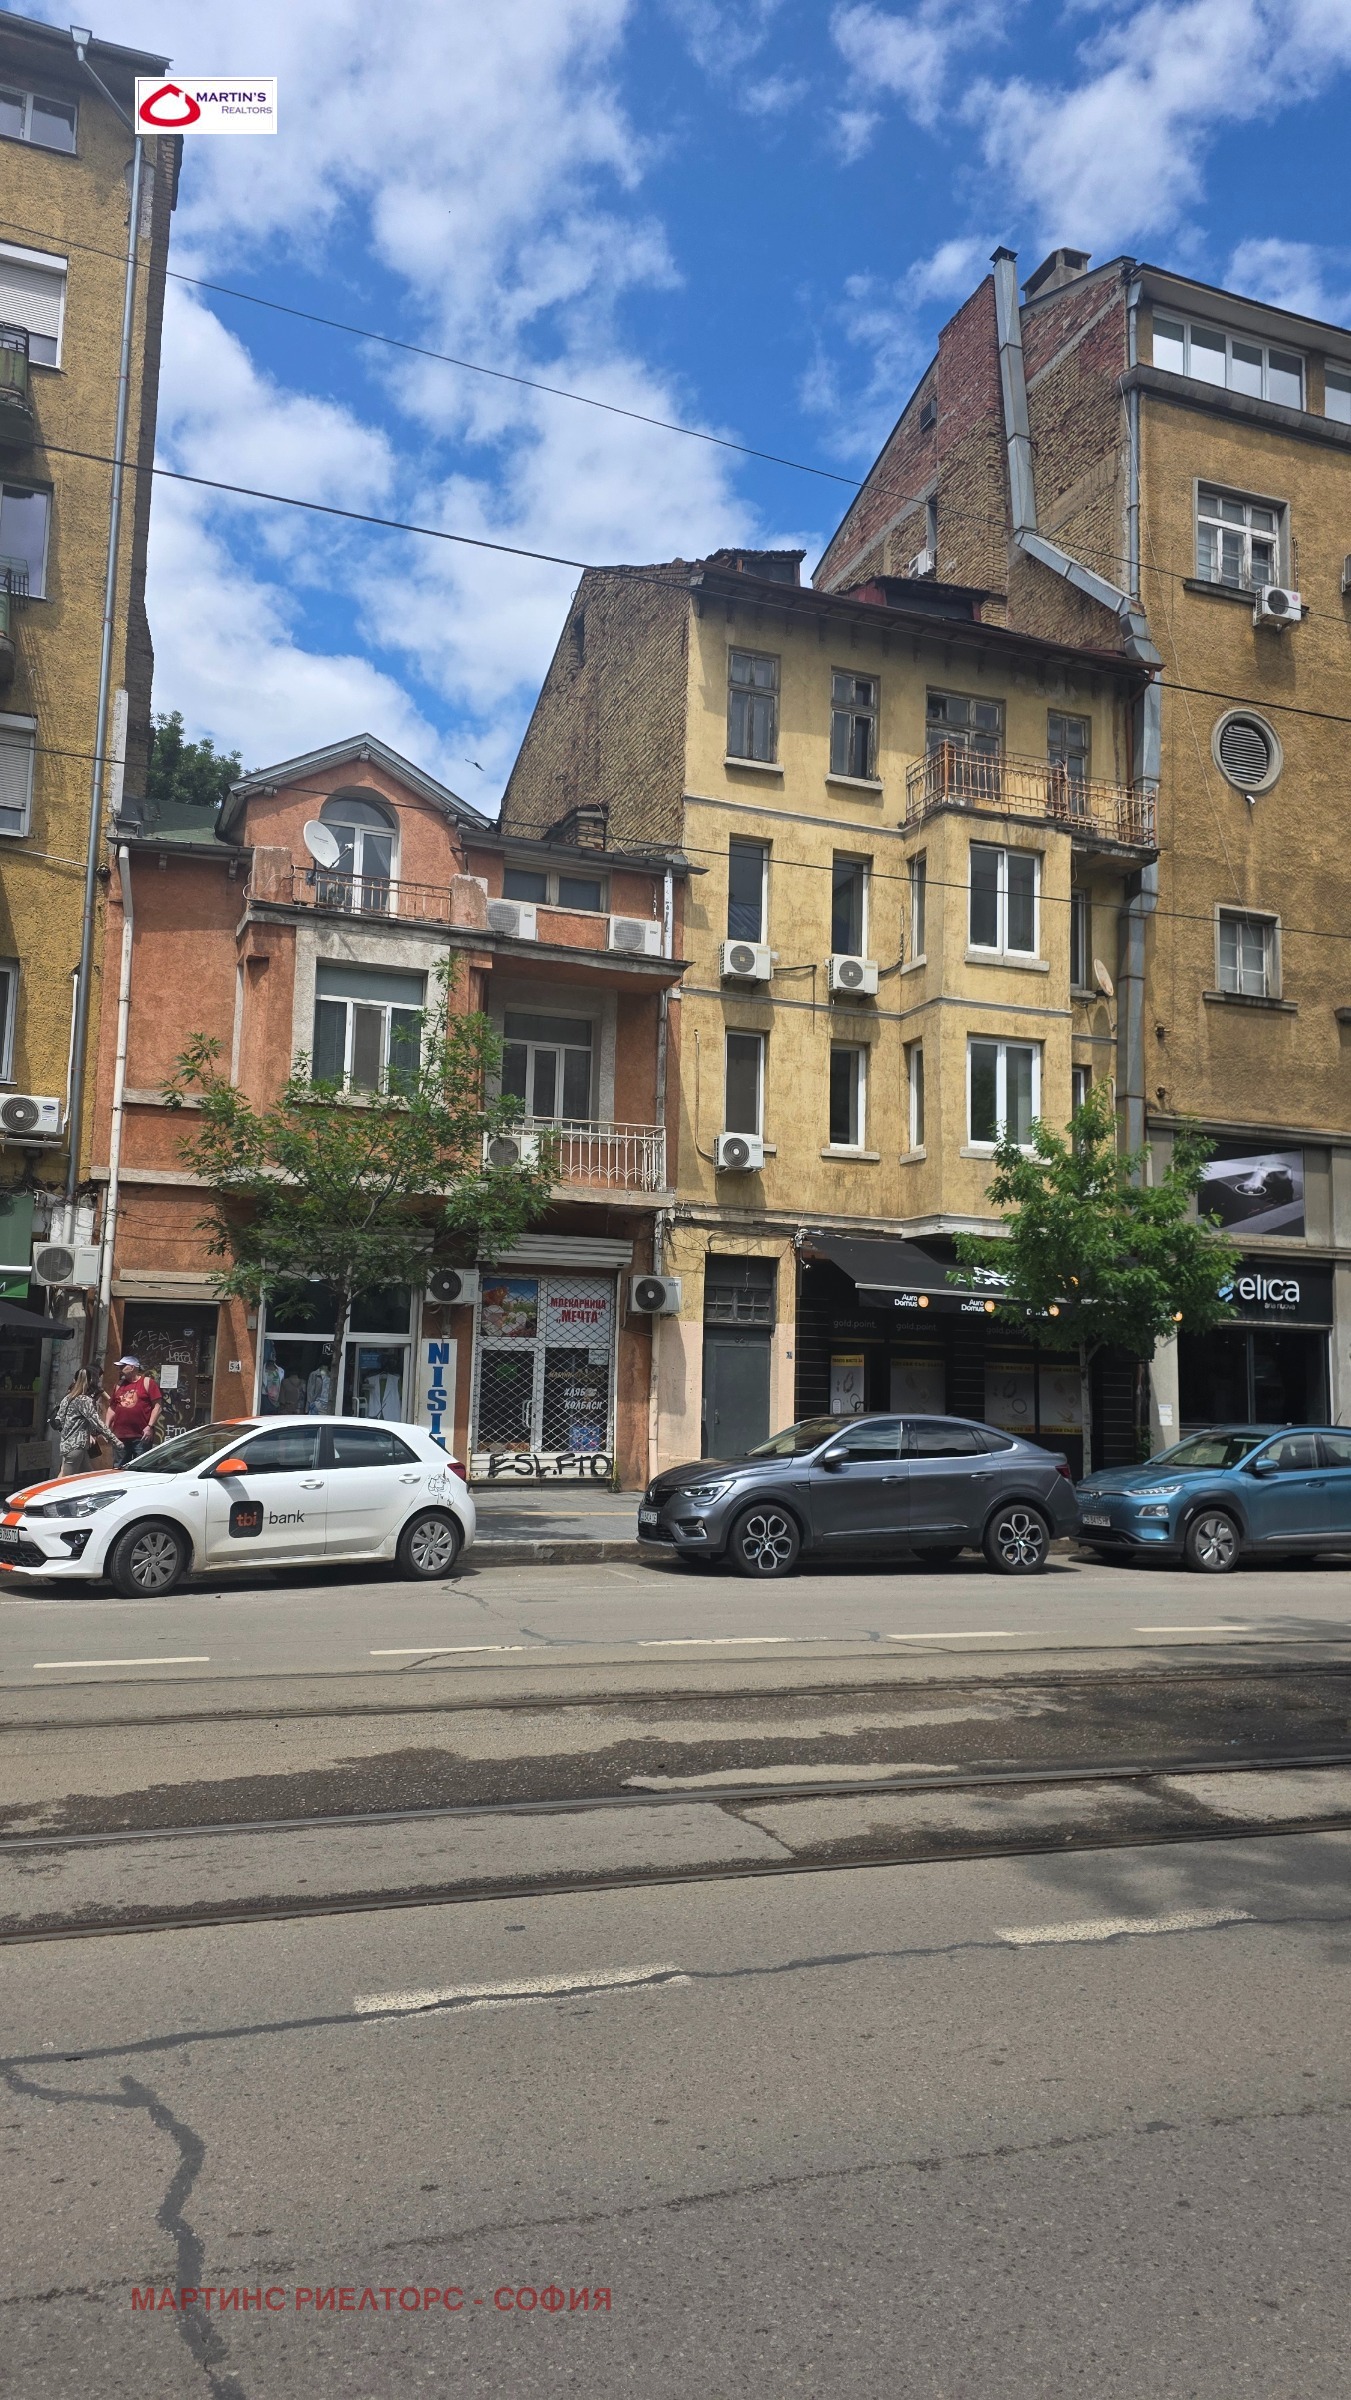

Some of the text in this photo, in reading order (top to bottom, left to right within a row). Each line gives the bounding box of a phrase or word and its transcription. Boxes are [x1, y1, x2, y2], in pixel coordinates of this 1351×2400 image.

[1240, 1274, 1299, 1302] elica
[550, 1298, 606, 1309] МЛЕКАРНИЦА
[895, 1299, 918, 1307] Domus
[961, 1304, 985, 1312] Domus
[230, 1362, 240, 1370] 54
[236, 1510, 305, 1527] tbi bank
